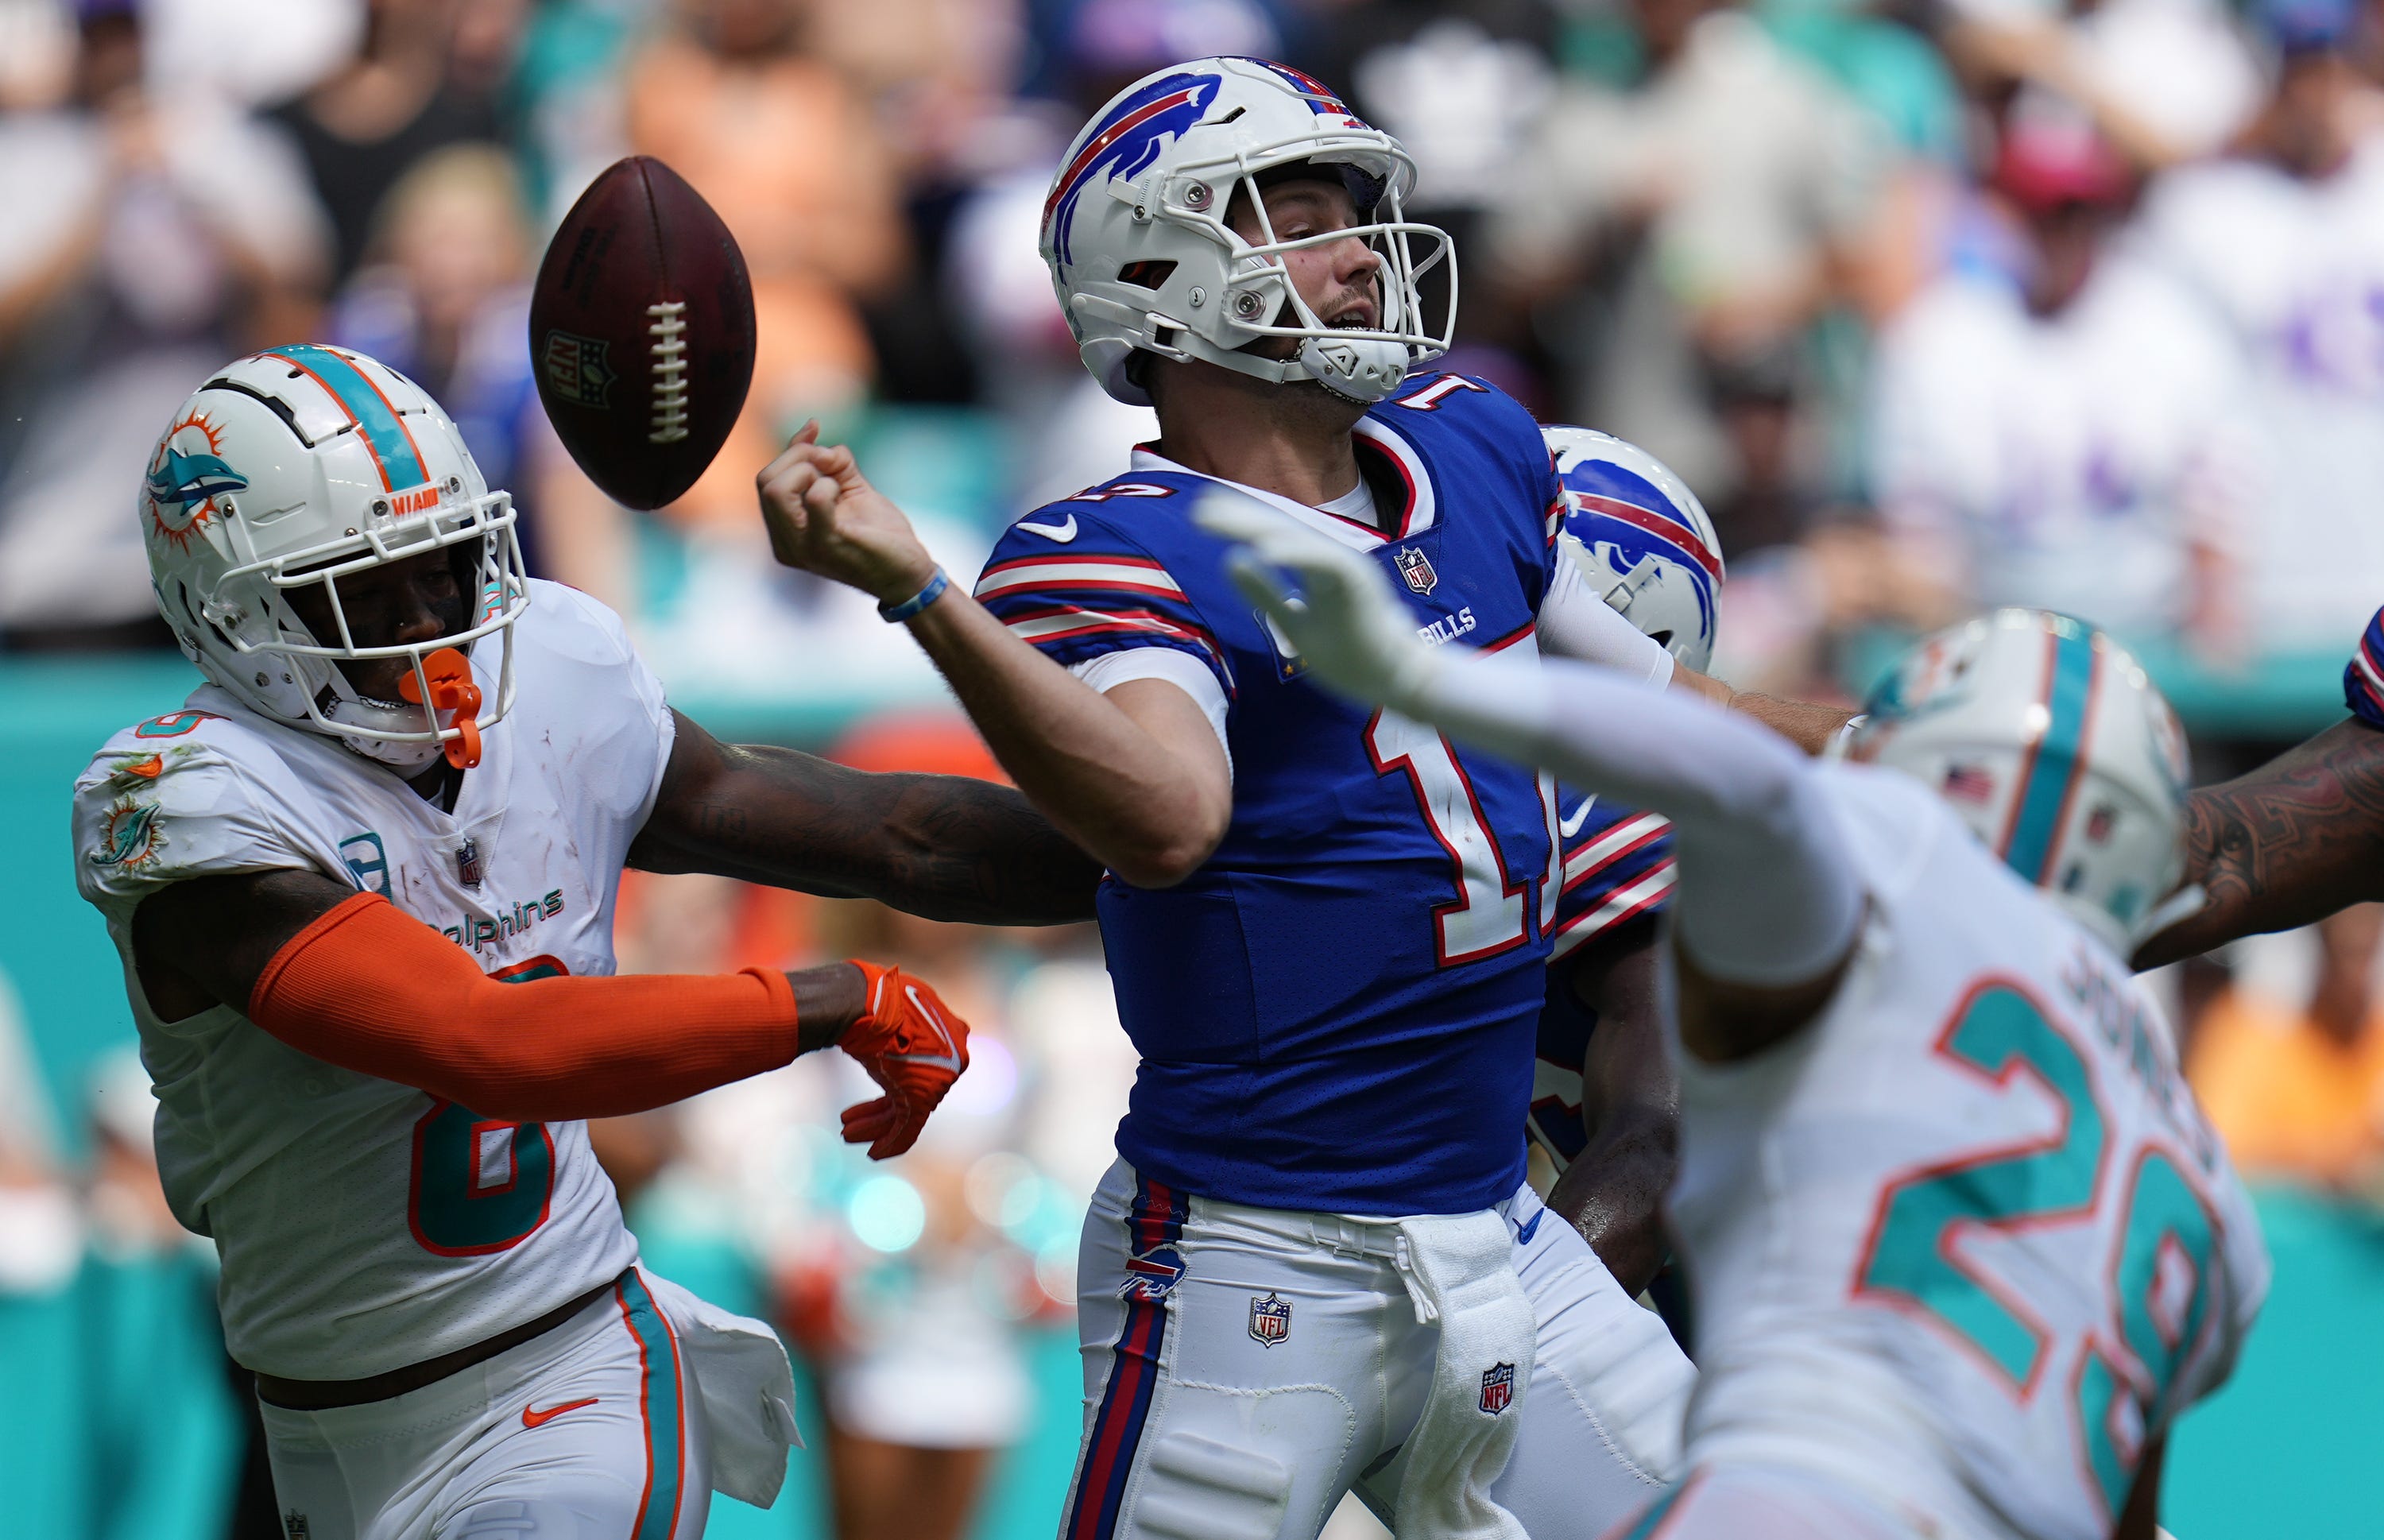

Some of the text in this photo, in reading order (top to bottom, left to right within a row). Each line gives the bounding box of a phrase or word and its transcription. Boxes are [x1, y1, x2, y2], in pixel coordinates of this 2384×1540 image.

[547, 337, 579, 393] NFL
[391, 487, 439, 517] MIAMI
[1407, 565, 1434, 586] NFL
[1416, 606, 1476, 648] BILLS
[426, 888, 565, 954] olphins
[1256, 1315, 1285, 1337] NFL
[1483, 1383, 1511, 1410] NFL
